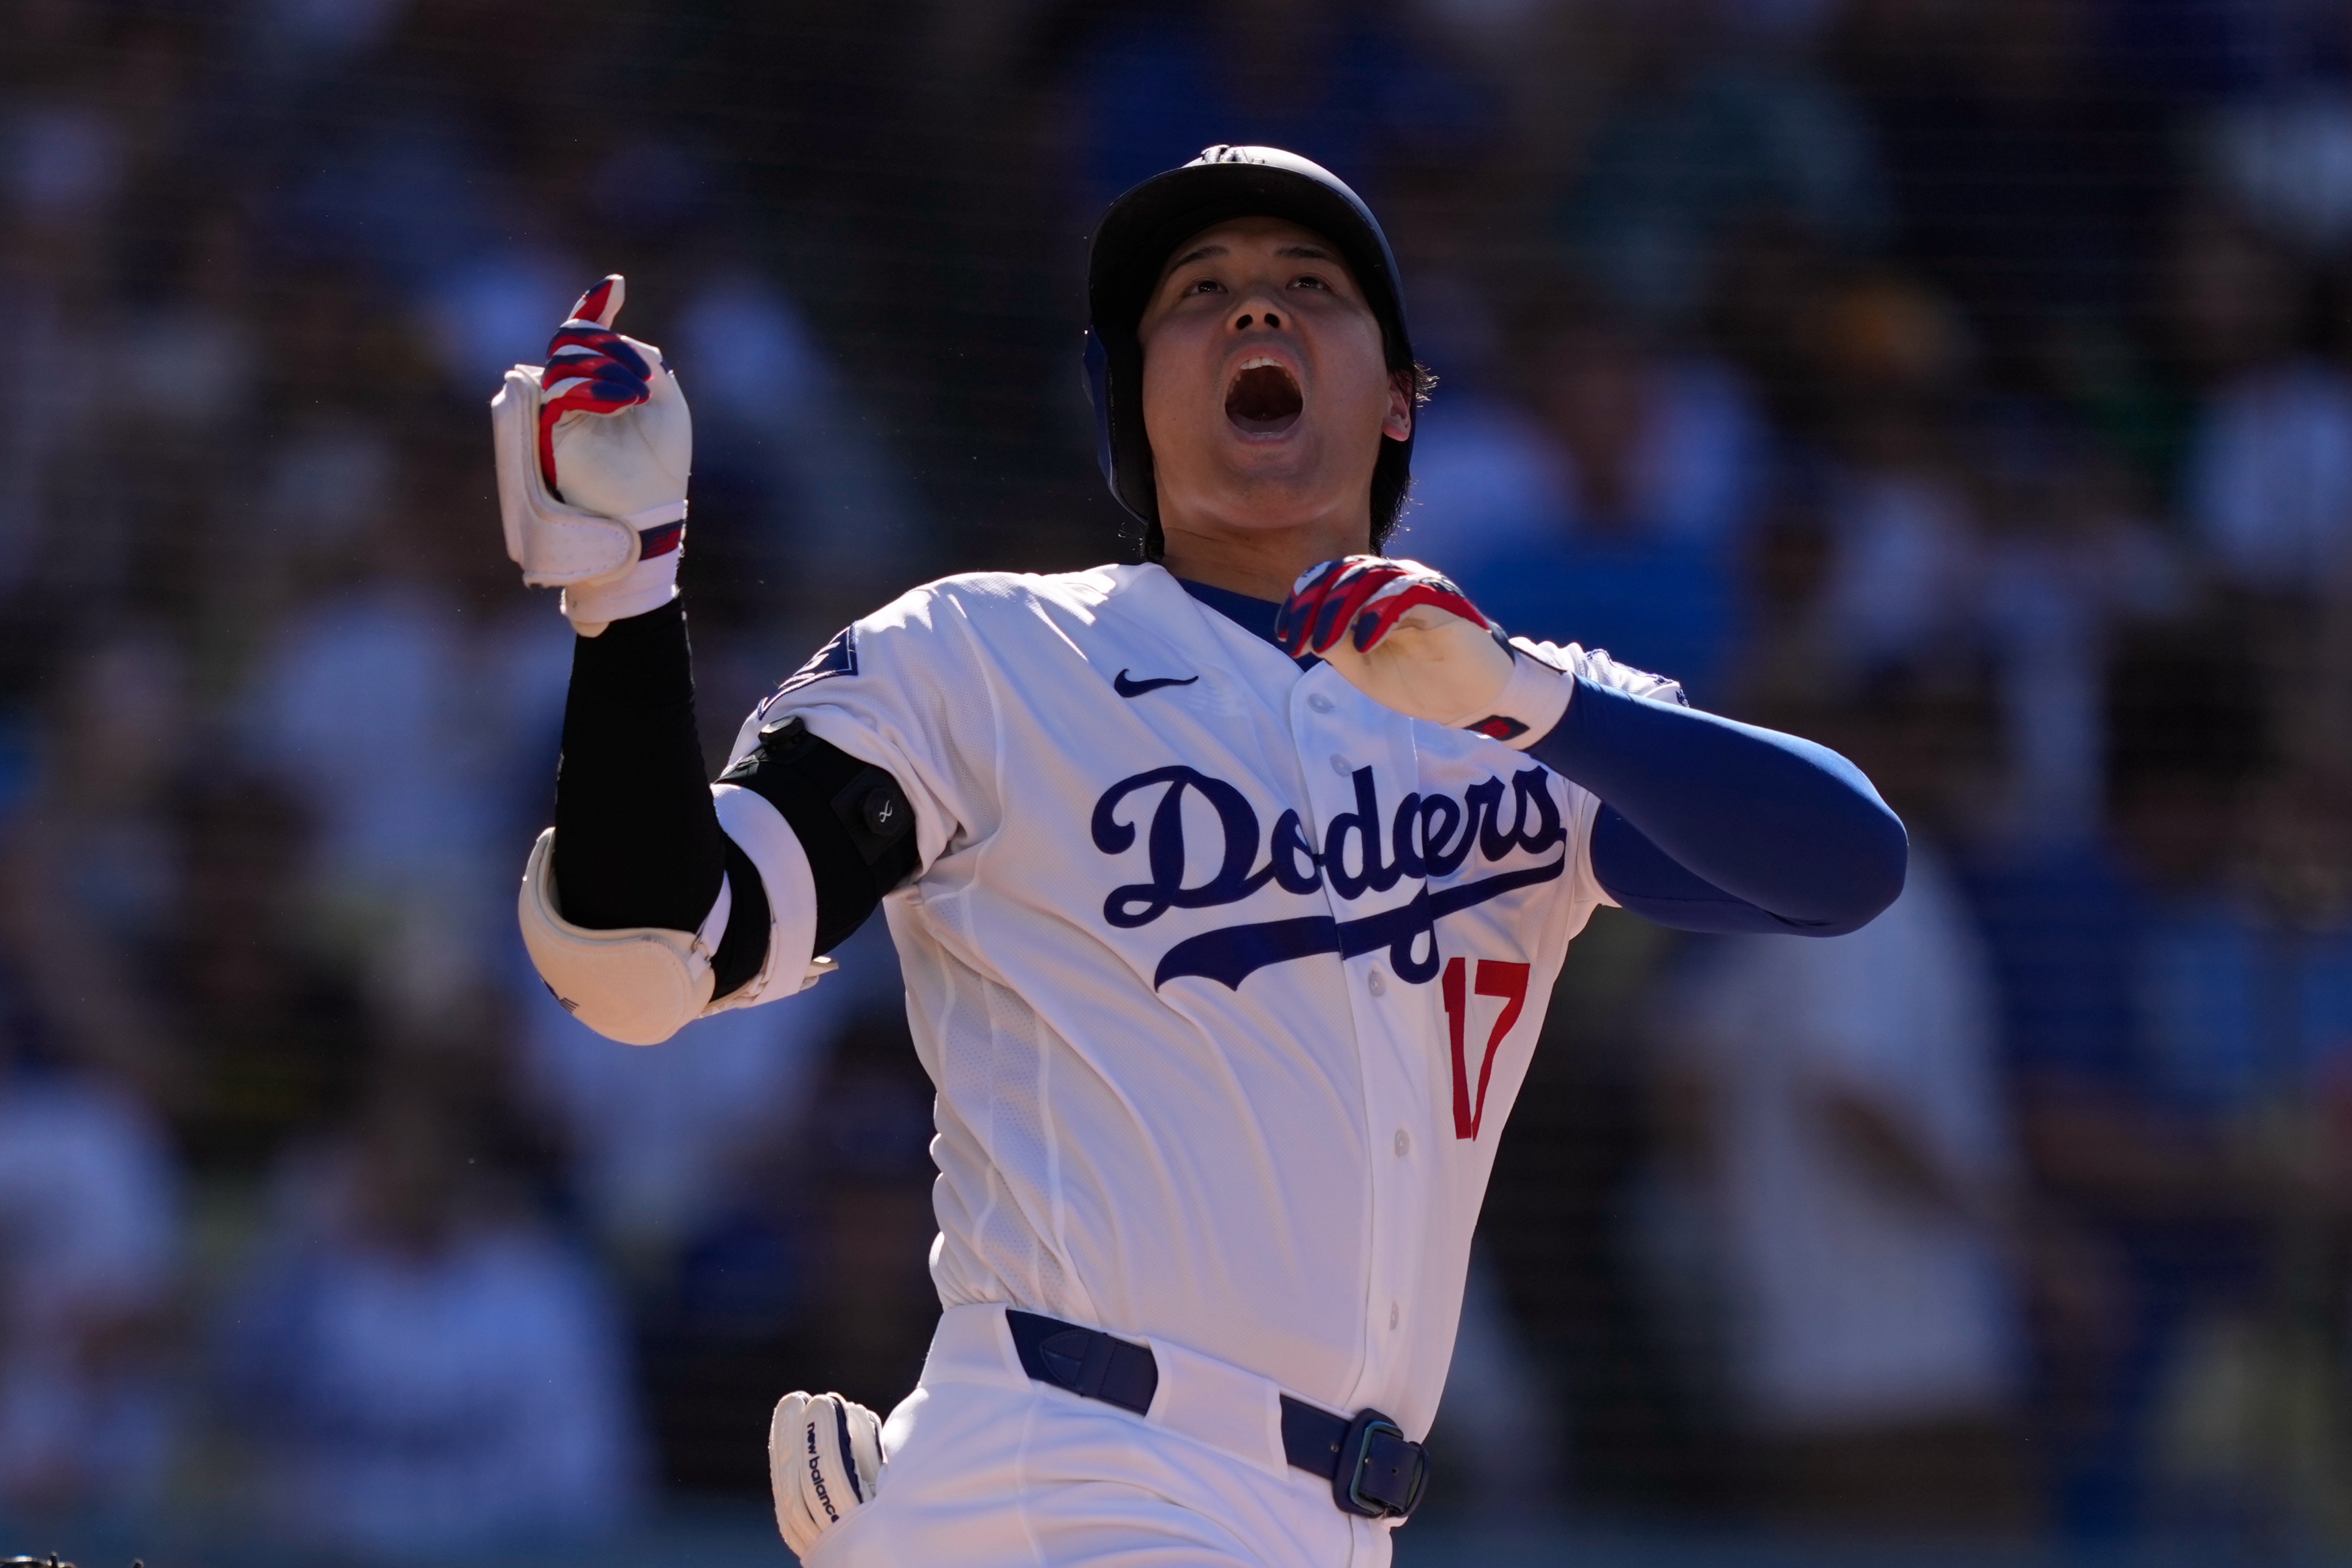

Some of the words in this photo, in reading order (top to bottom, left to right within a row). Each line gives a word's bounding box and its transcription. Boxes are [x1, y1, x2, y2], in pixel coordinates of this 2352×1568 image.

[1091, 765, 1568, 992] Dodgers
[1442, 957, 1531, 1142] 17
[807, 1422, 817, 1454] new
